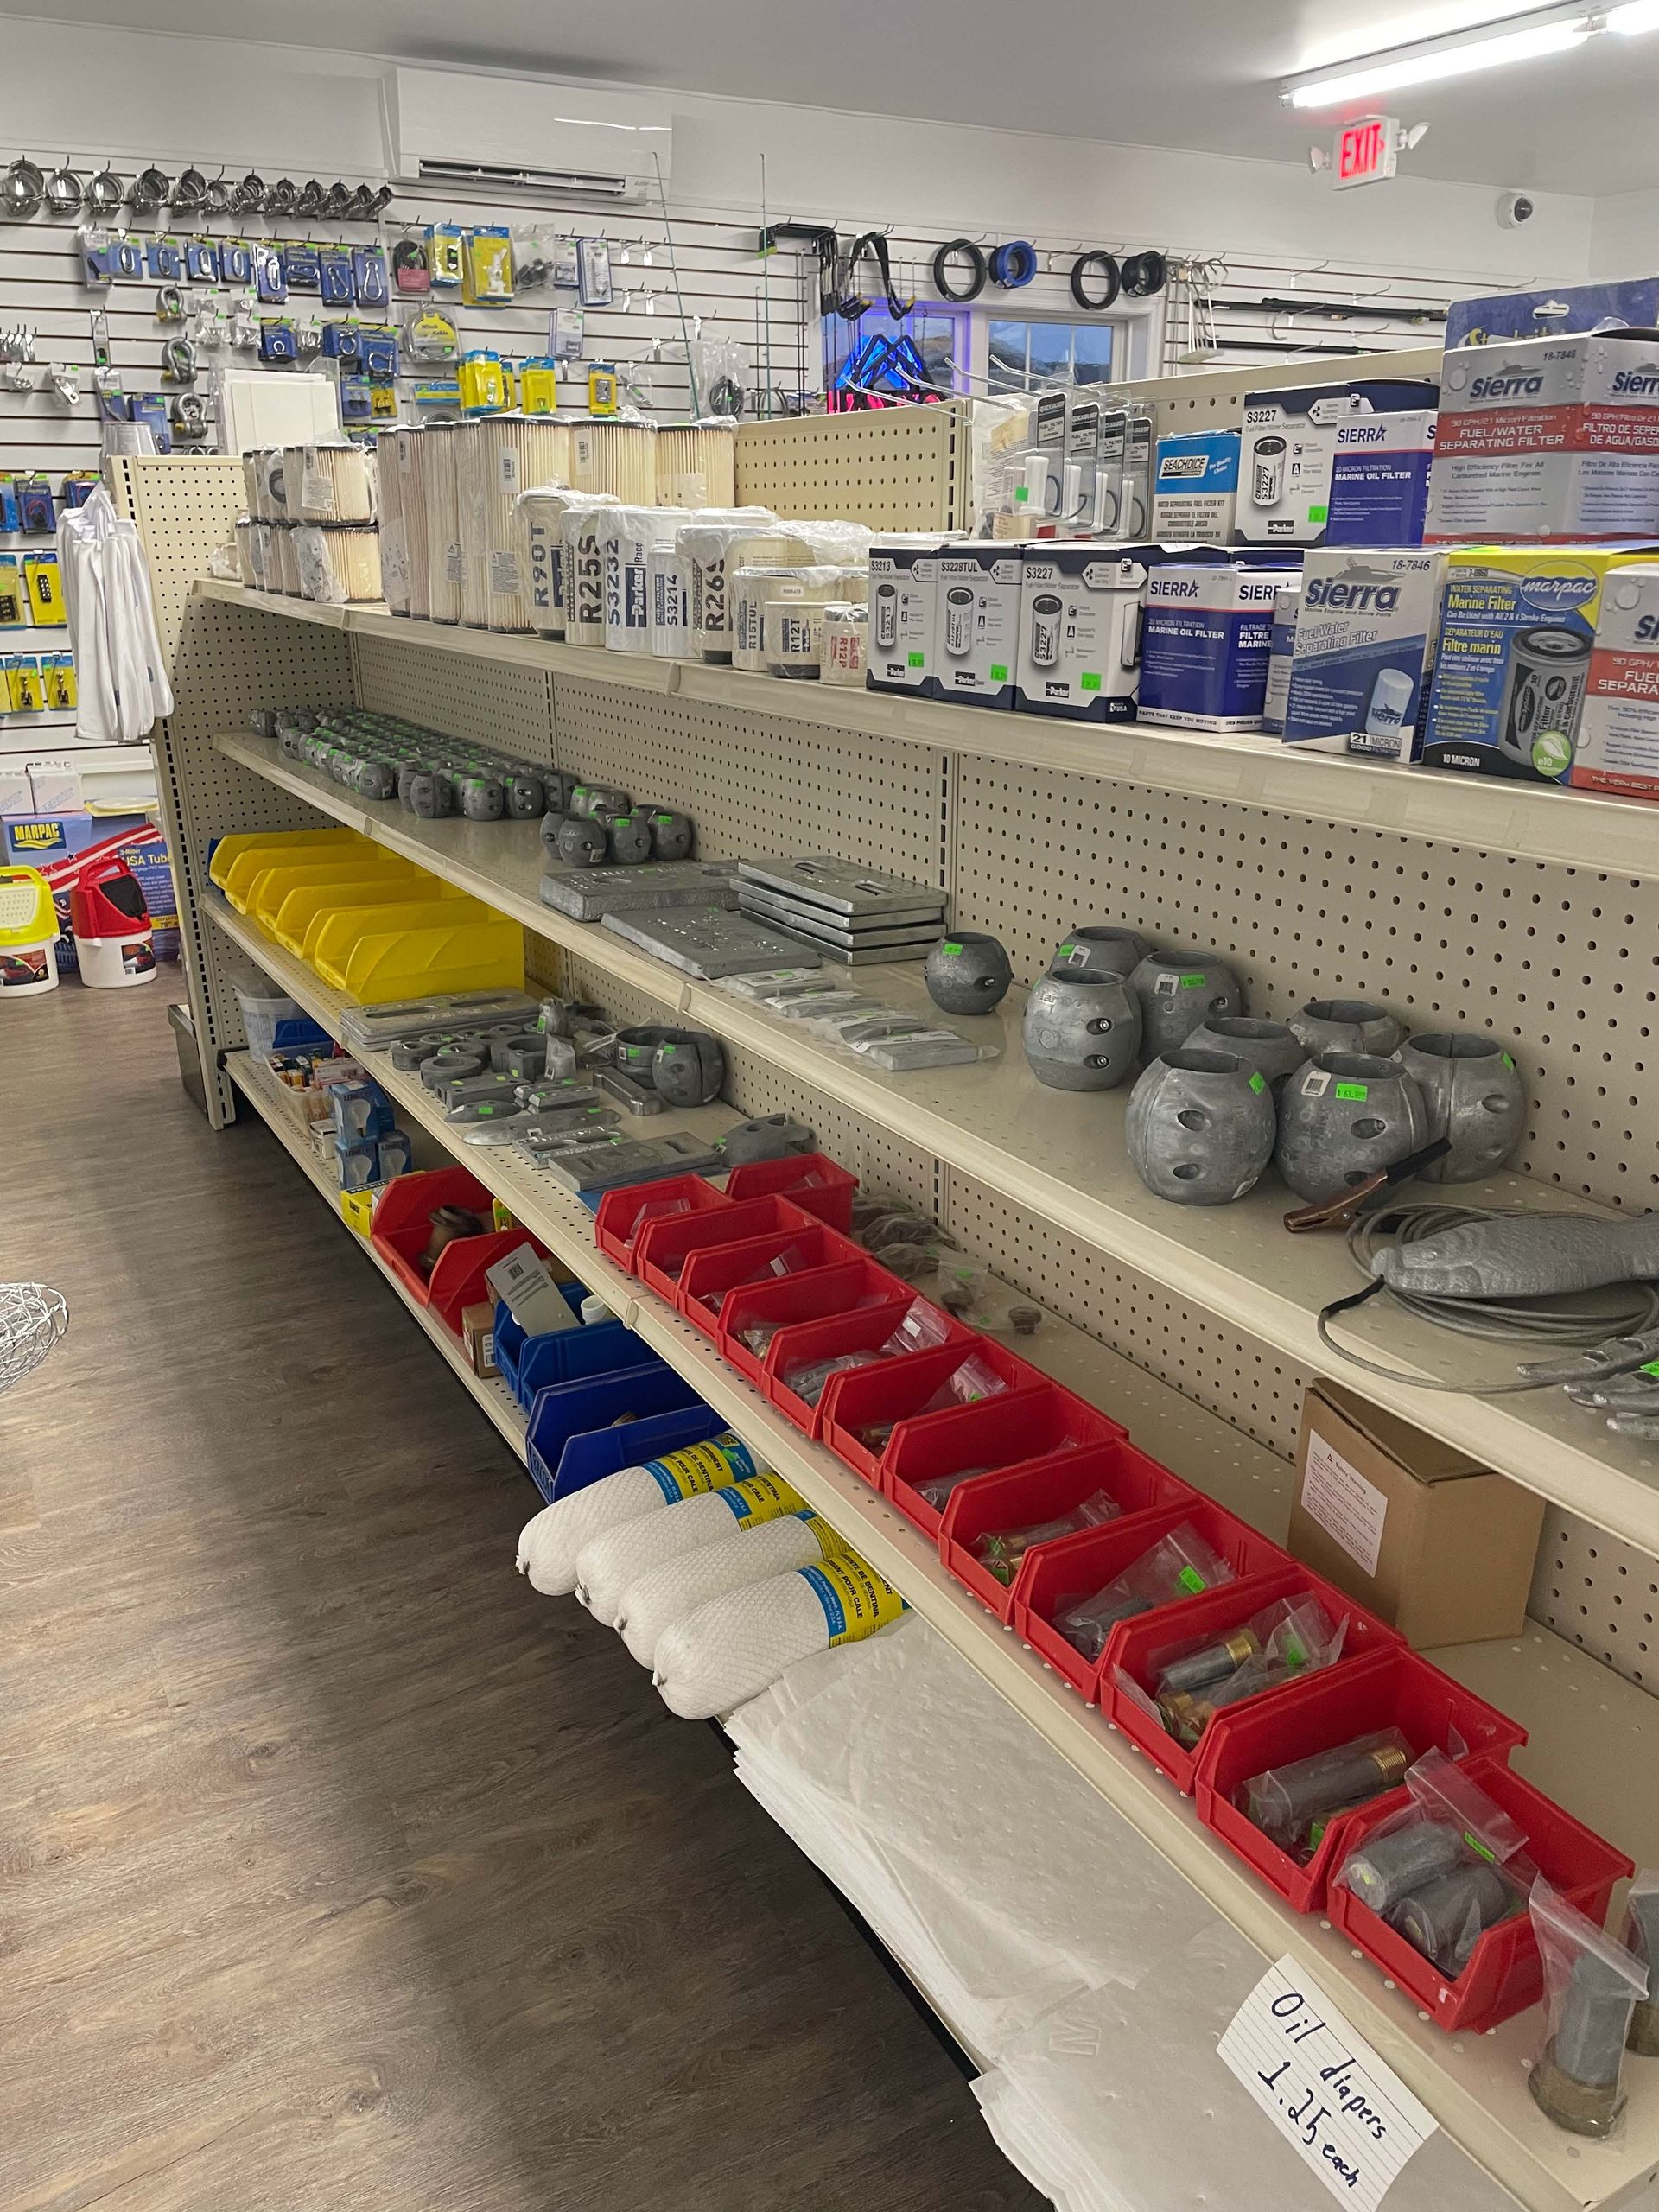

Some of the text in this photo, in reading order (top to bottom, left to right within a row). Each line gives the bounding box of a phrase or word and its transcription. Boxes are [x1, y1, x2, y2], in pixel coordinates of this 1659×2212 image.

[1340, 123, 1382, 180] EXIT
[1470, 376, 1544, 397] Sierra
[1246, 410, 1277, 423] S3227
[1495, 416, 1521, 424] Micron
[1521, 414, 1556, 423] Filtration
[1338, 424, 1387, 443] SIERRA
[1459, 425, 1543, 438] FUEL/WATER
[1582, 423, 1616, 433] FILTRO
[1618, 424, 1631, 434] DE
[1439, 435, 1564, 451] SEPARATING FILTER
[1590, 435, 1604, 444] DE
[1163, 458, 1205, 470] SEACHOICE
[1335, 472, 1364, 480] MARINE
[531, 522, 549, 607] R90T
[871, 560, 891, 572] S3213
[941, 562, 978, 574] S3228TUL
[1026, 567, 1053, 580] S3227
[1391, 559, 1431, 571] 18-7846
[578, 535, 602, 623] R25S
[607, 539, 620, 626] S3232
[1150, 580, 1199, 597] SIERRA
[631, 569, 645, 615] Parker
[705, 558, 724, 631] R26S
[1239, 582, 1287, 601] SIERR
[1305, 578, 1401, 612] Sierra
[1451, 585, 1471, 594] WATER
[1521, 580, 1596, 601] marpac
[667, 575, 677, 626] S3214
[1447, 594, 1516, 611] Marine Filter
[748, 601, 757, 649] R15TUL
[1174, 620, 1205, 629] FILTRATION
[1519, 613, 1539, 622] Stroke
[791, 619, 800, 652] R12T
[1148, 626, 1224, 639] MARINE OIL FILTER
[1297, 626, 1318, 641] Fuel
[1319, 621, 1350, 637] Water
[1295, 636, 1347, 656] Separating
[1348, 630, 1378, 645] Filter
[1442, 637, 1502, 655] Filtre marin
[839, 637, 848, 669] R12P
[1540, 704, 1551, 731] Filter
[1352, 734, 1400, 749] 21 MICRON
[1442, 753, 1480, 767] 10 MICRON
[14, 823, 60, 842] MARPAC
[677, 1459, 699, 1493] POUR CALE
[696, 1461, 714, 1492] SENTINA
[752, 1488, 765, 1503] CALE
[760, 1478, 781, 1501] SENTINA
[842, 1575, 863, 1619] POUR CALE
[858, 1570, 880, 1618] DE SENTINA
[1272, 1993, 1386, 2139] Oil diapers
[1258, 2062, 1360, 2188] 1.25 each
